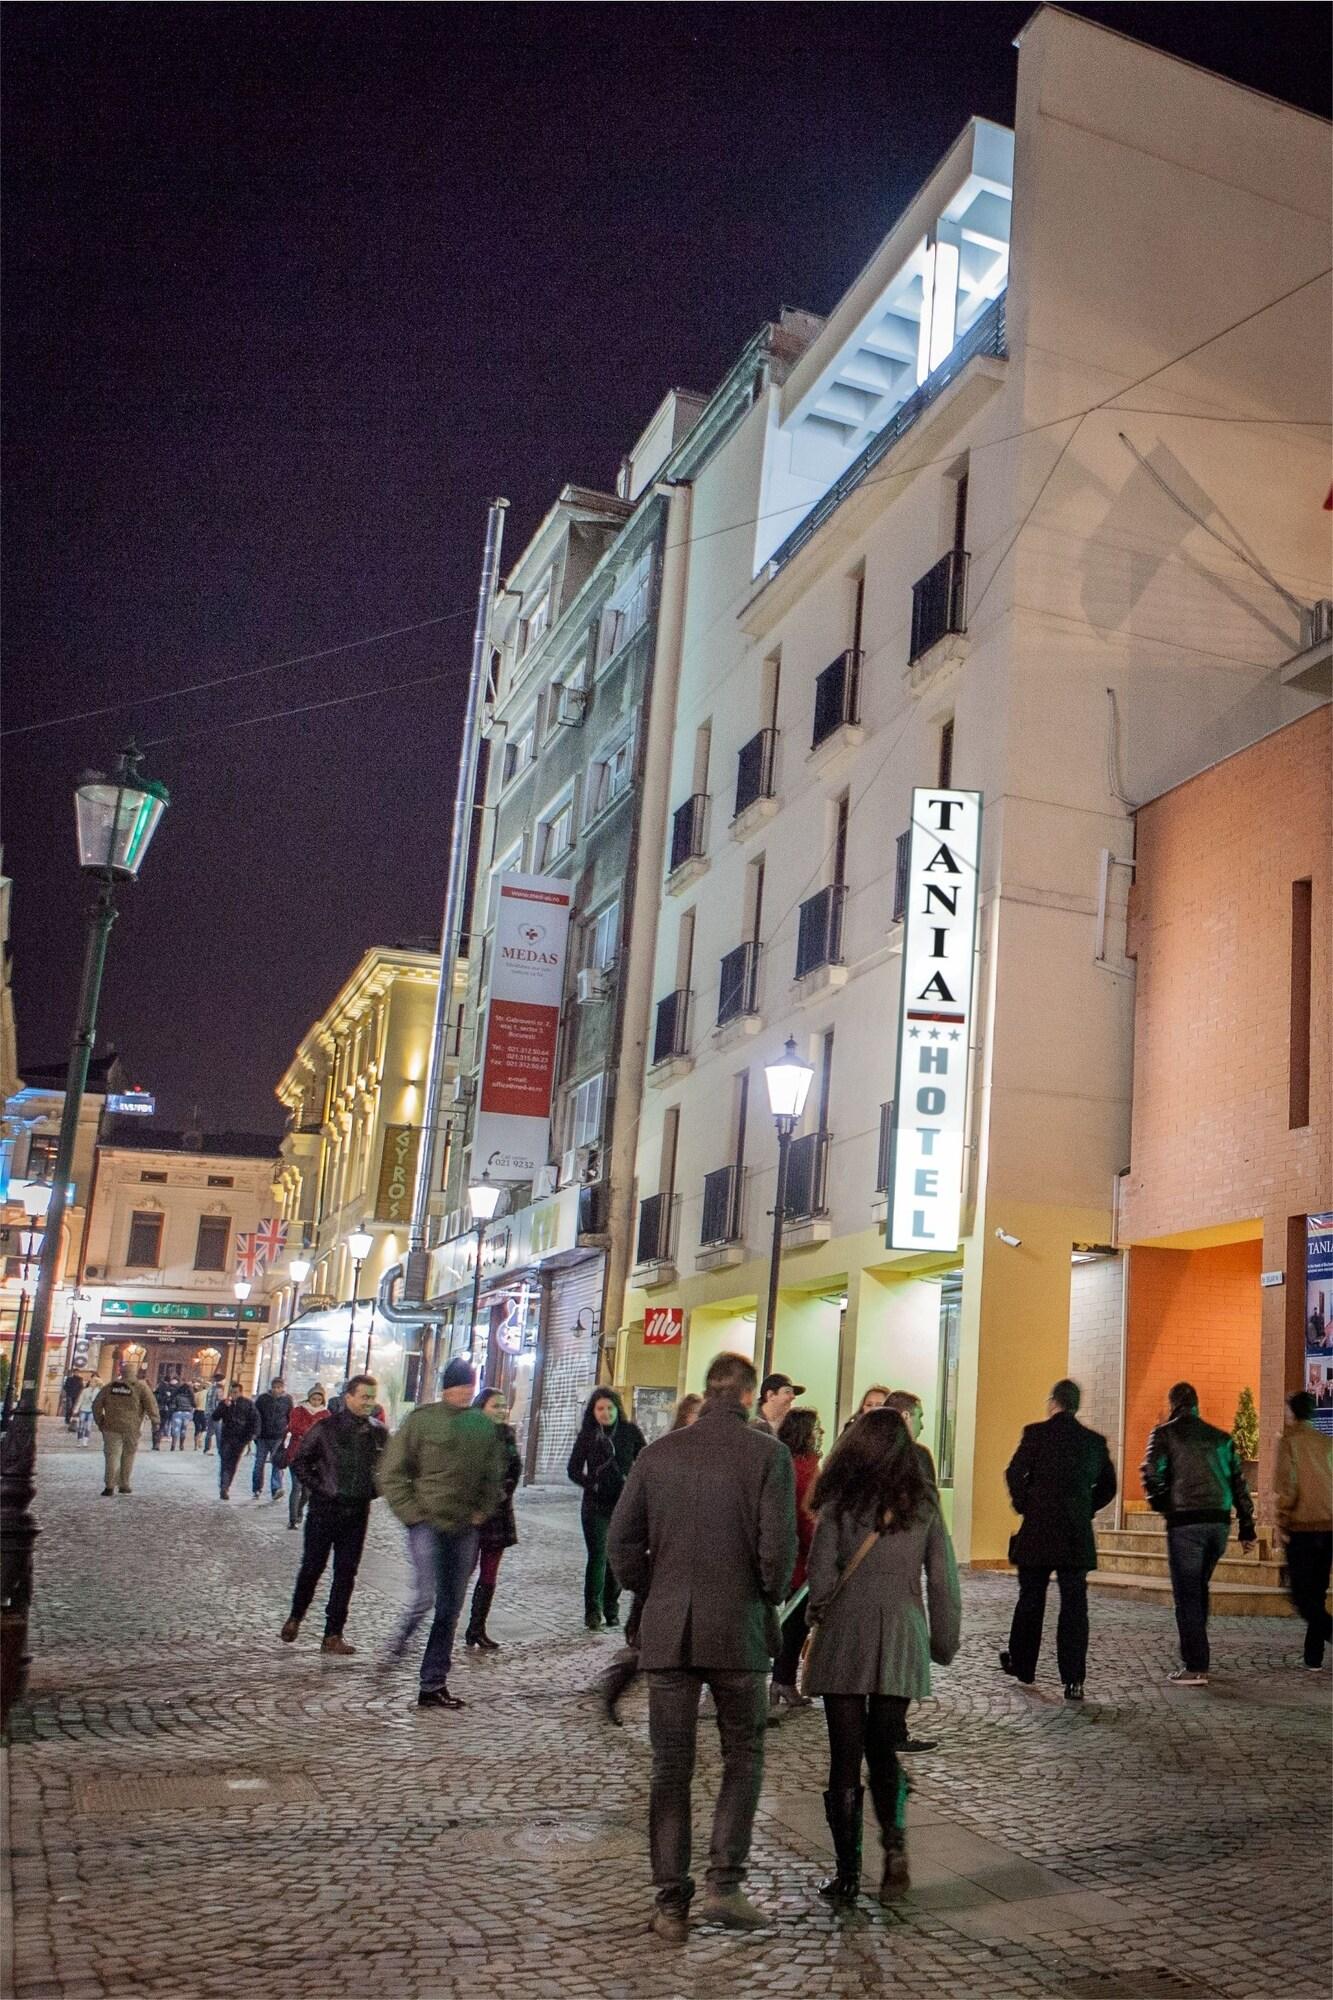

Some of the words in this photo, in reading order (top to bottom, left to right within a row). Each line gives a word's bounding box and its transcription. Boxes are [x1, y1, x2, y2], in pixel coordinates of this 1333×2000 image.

[915, 799, 964, 1003] TANIA
[501, 947, 559, 965] MEDAS
[911, 1045, 949, 1239] HOTEL
[388, 1130, 410, 1218] GYROS
[495, 1159, 510, 1167] 021
[513, 1160, 535, 1169] 9232
[151, 1303, 171, 1314] Old
[171, 1304, 190, 1319] City
[646, 1309, 681, 1342] illy
